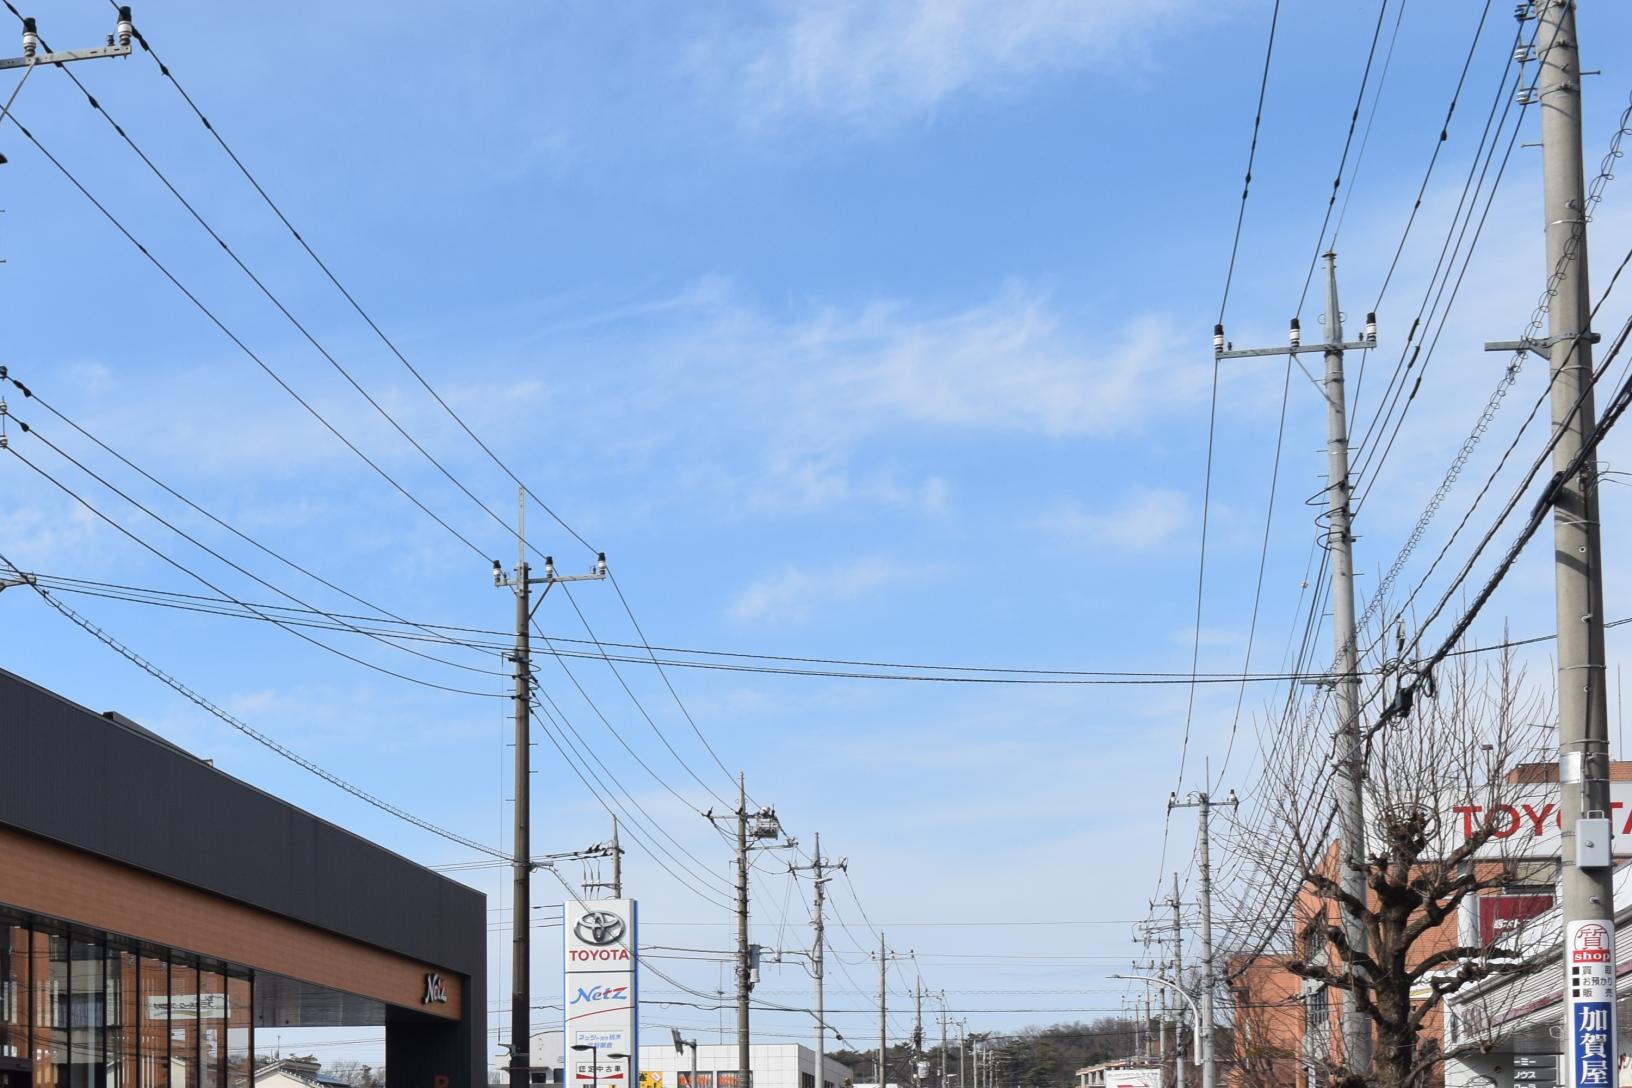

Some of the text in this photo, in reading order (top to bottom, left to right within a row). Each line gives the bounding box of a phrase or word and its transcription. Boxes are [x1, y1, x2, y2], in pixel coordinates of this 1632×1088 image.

[1452, 803, 1632, 840] TOY
[569, 949, 630, 961] TOYOTA
[1575, 951, 1610, 962] shop
[424, 973, 448, 1004] Netz
[570, 985, 628, 1004] Netz
[1578, 1006, 1609, 1085] 加賀屋
